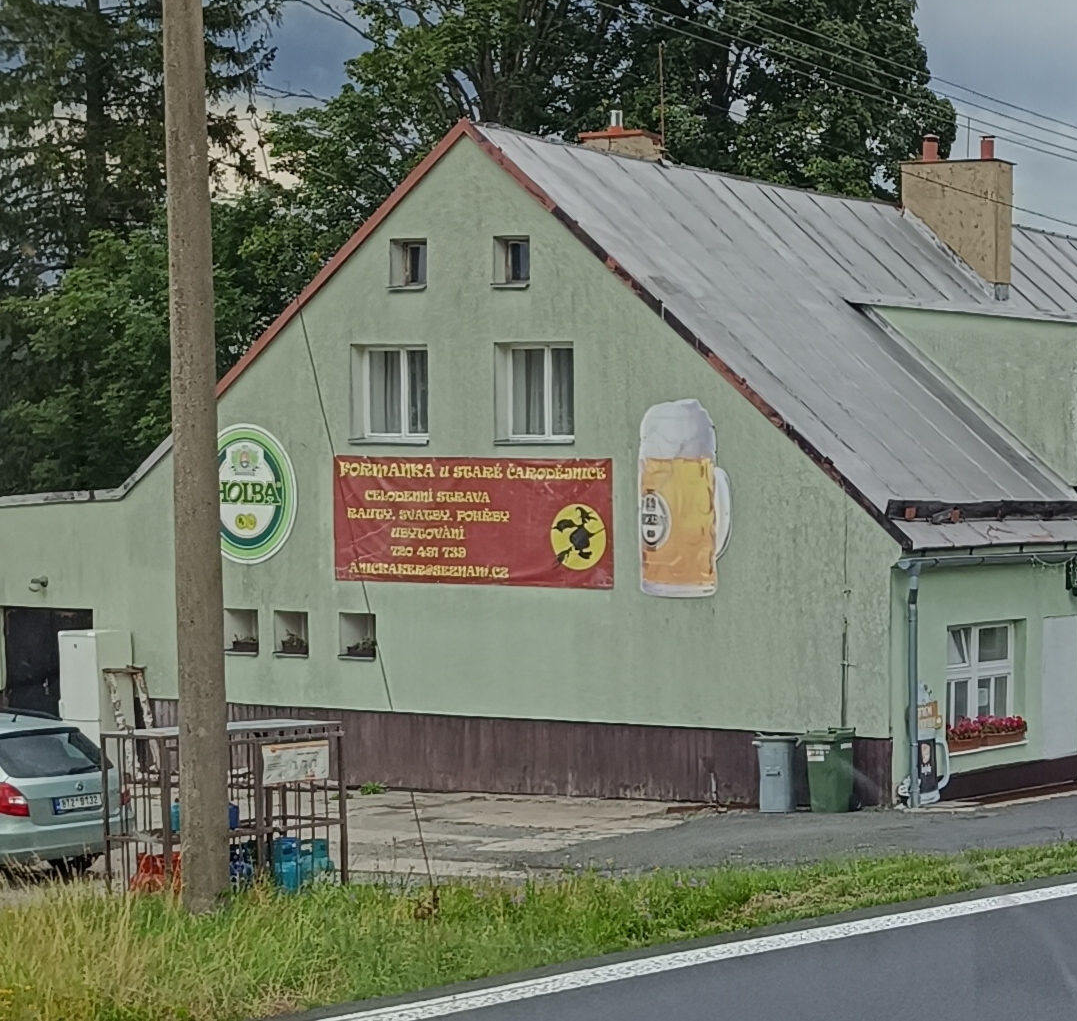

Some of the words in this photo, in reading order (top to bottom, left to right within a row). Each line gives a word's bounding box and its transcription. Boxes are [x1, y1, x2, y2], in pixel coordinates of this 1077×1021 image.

[339, 461, 435, 478] FORMANKA
[452, 462, 503, 479] STARÉ
[507, 463, 607, 480] ČARODĚJNICE
[364, 488, 434, 503] CELODENNÍ
[436, 491, 491, 503] STRAVA
[456, 507, 511, 523] POHŘBY
[390, 525, 466, 540] UBYTOVÁNÍ
[390, 545, 413, 557] 720
[442, 546, 467, 558] 739
